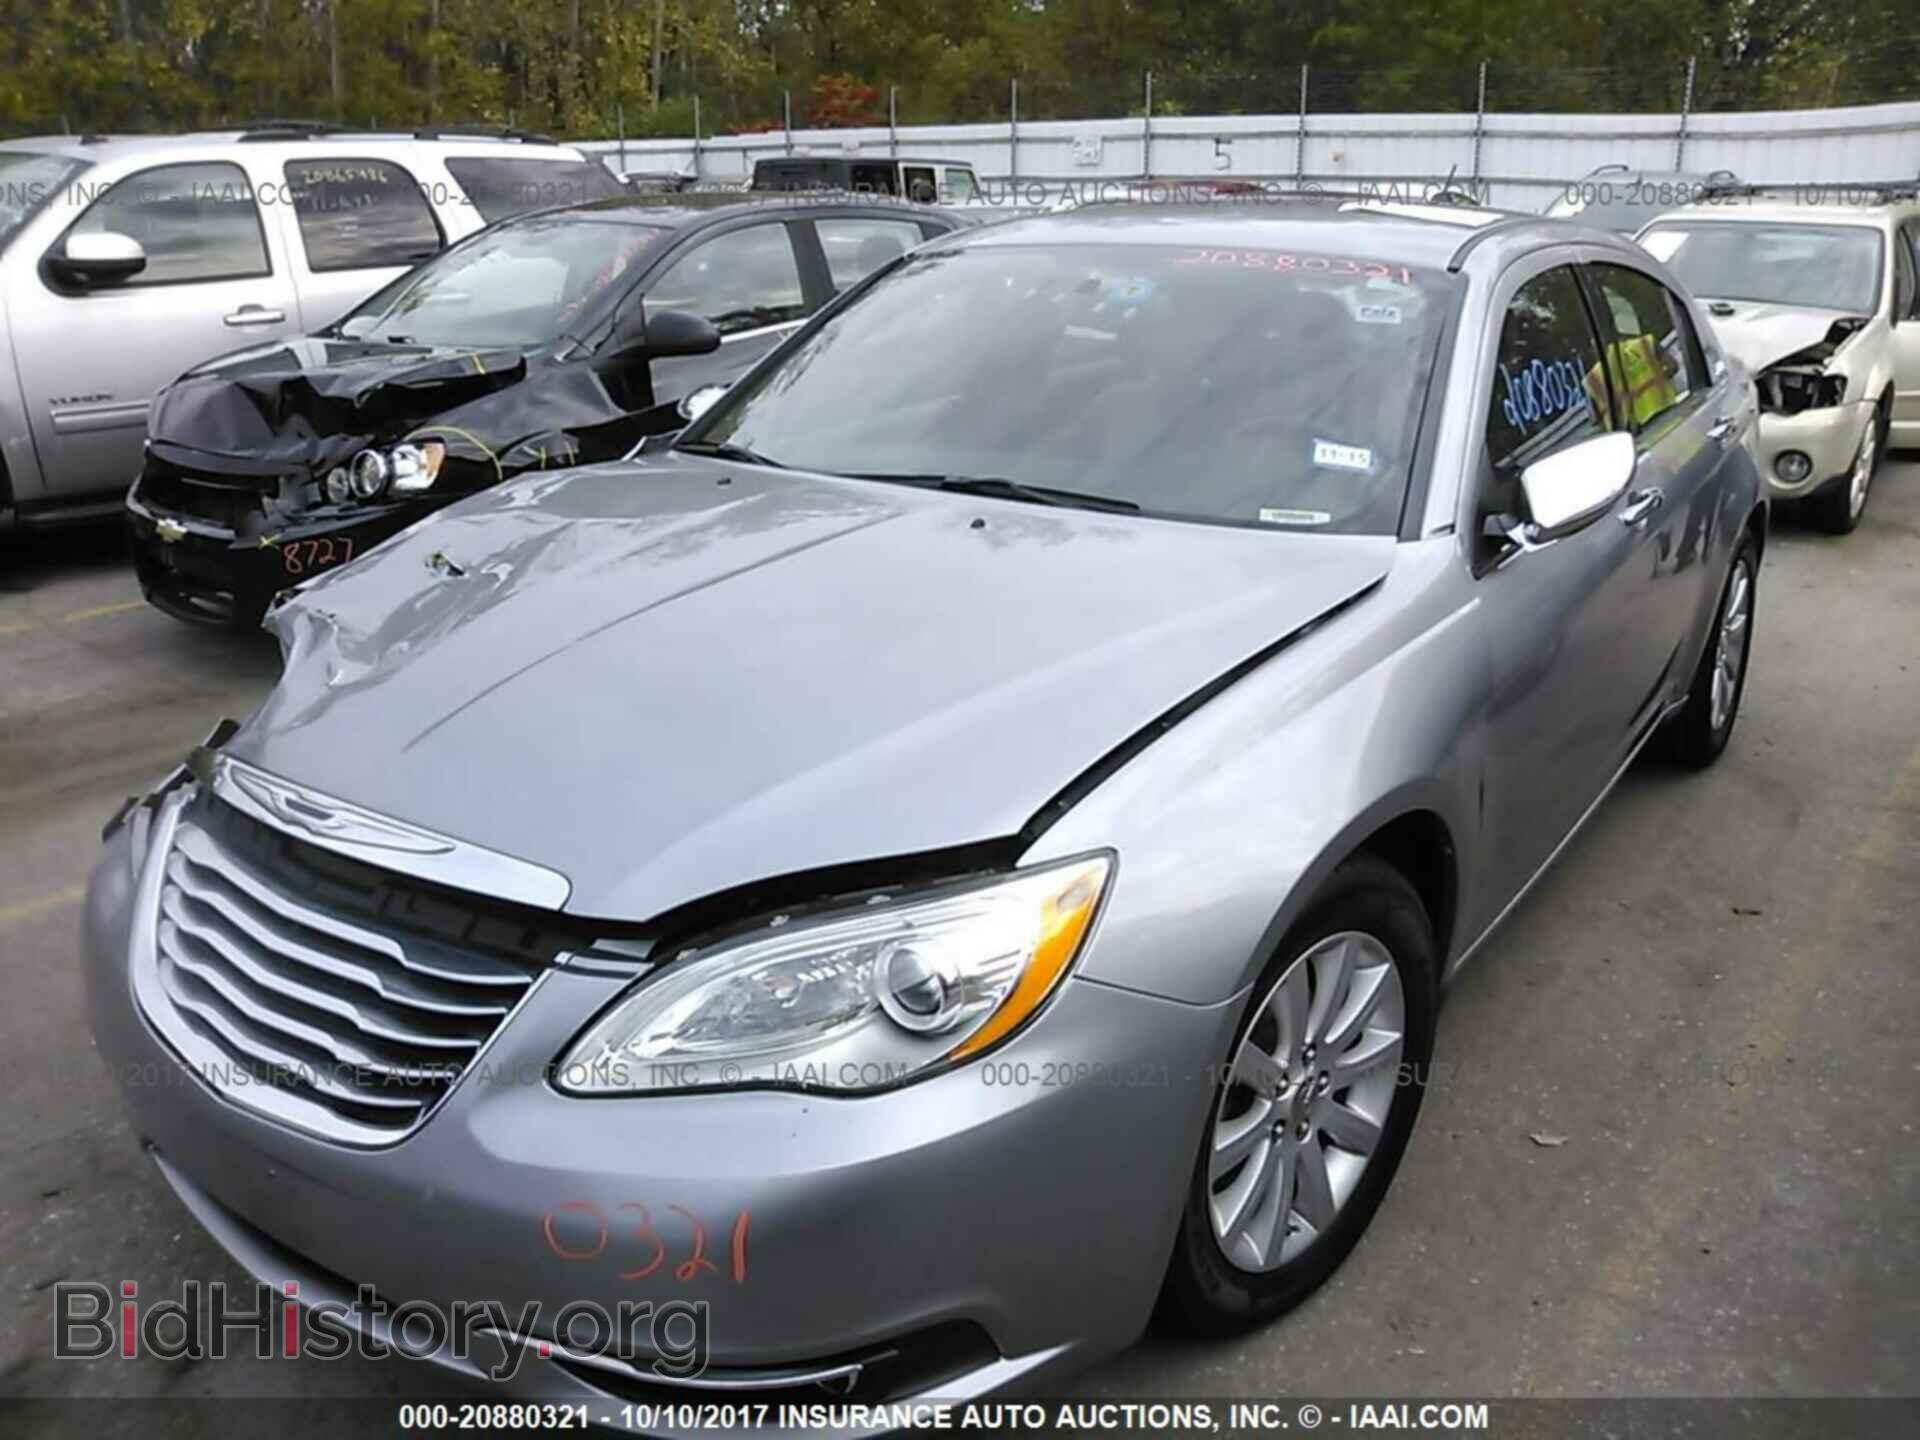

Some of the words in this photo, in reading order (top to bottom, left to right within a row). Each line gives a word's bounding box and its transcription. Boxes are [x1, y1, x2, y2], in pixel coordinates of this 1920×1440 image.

[1213, 138, 1232, 171] 5
[283, 541, 353, 574] 8727
[544, 1201, 750, 1283] 0321
